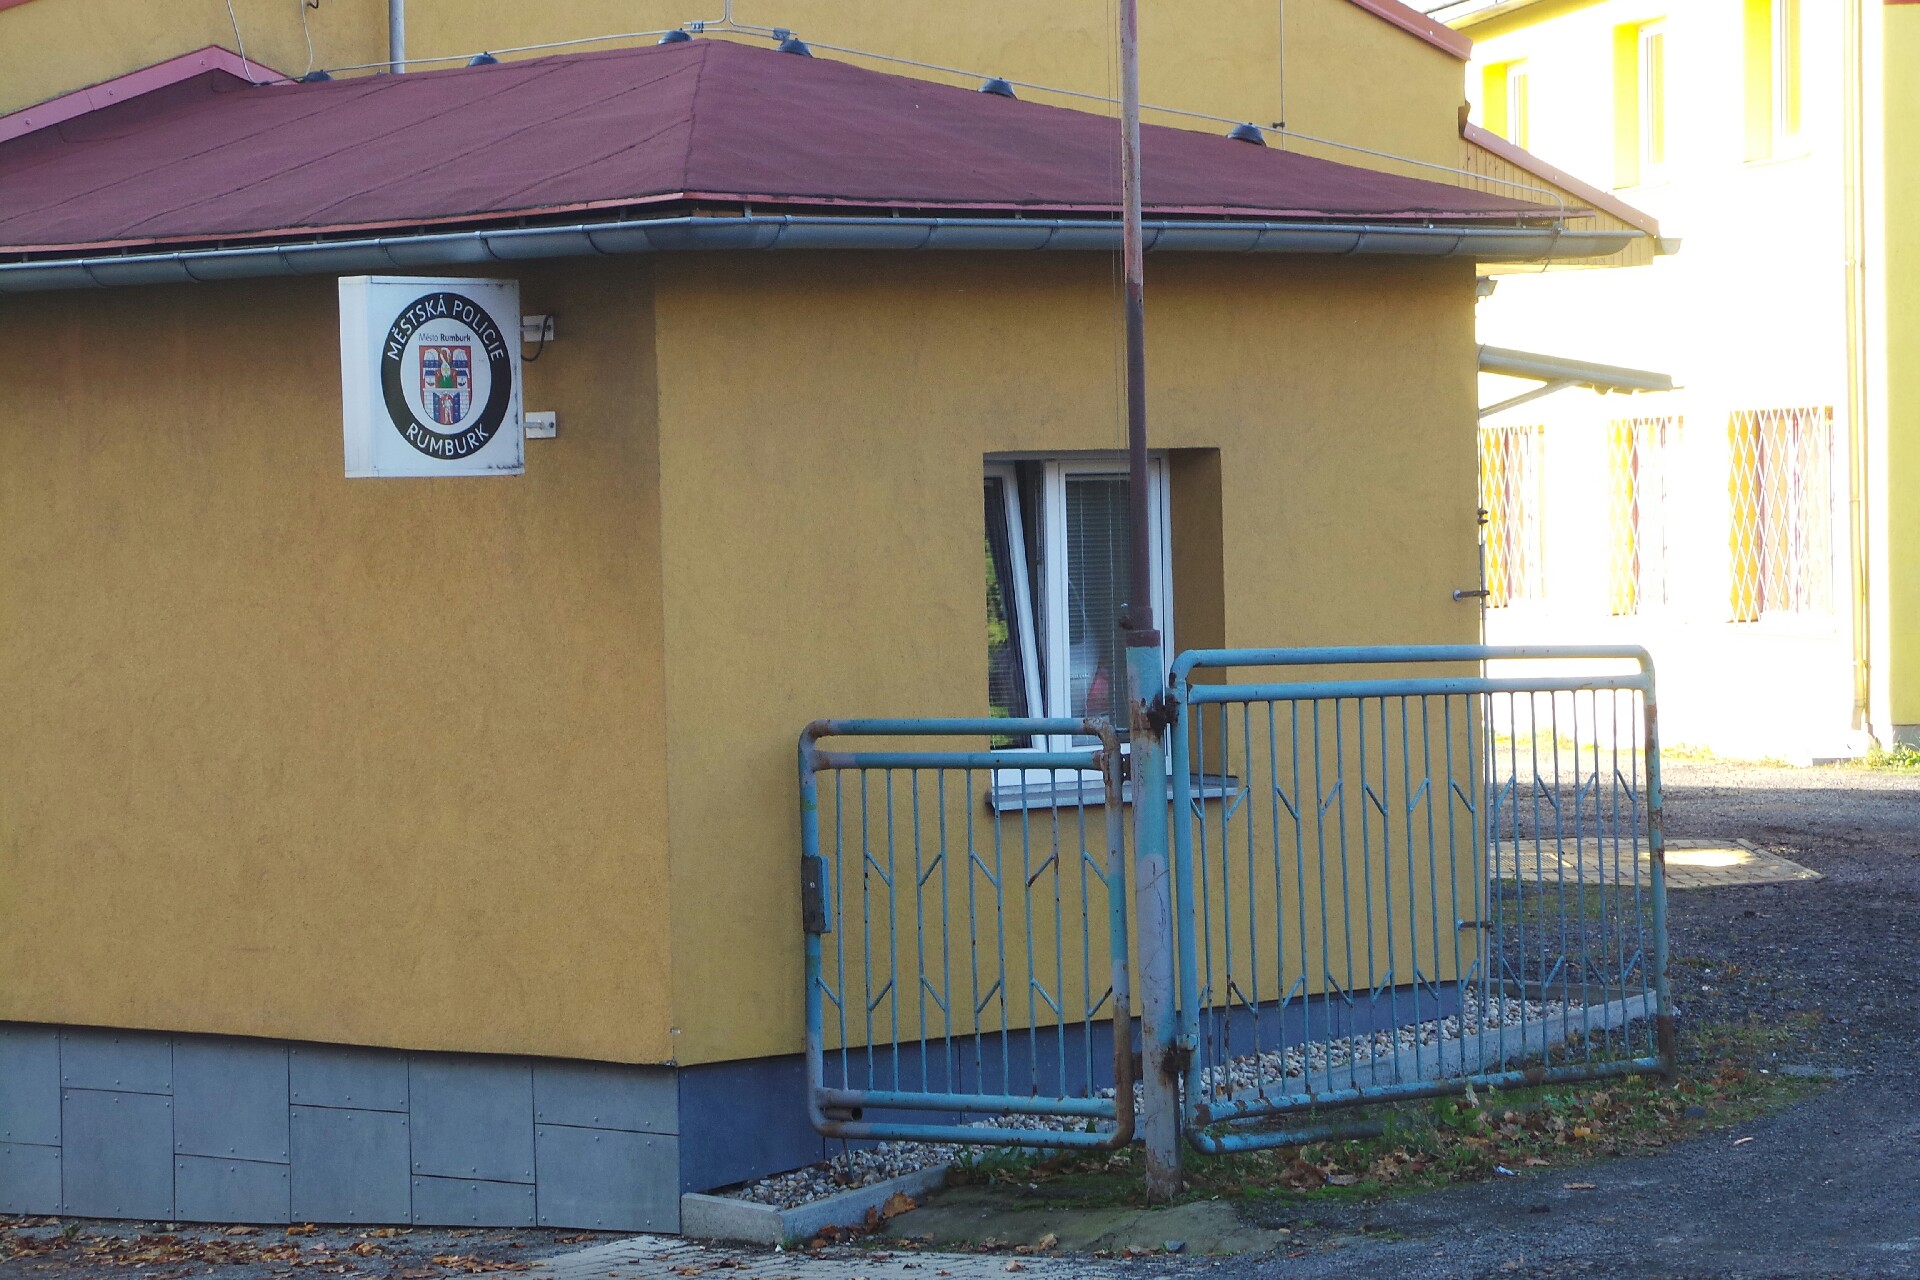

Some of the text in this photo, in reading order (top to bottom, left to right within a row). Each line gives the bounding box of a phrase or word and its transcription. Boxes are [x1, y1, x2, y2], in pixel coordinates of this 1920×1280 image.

[387, 294, 504, 362] MĚSTSKÁ POLICIE
[418, 332, 471, 342] Město Rumburk
[405, 422, 489, 456] RUMBURK
